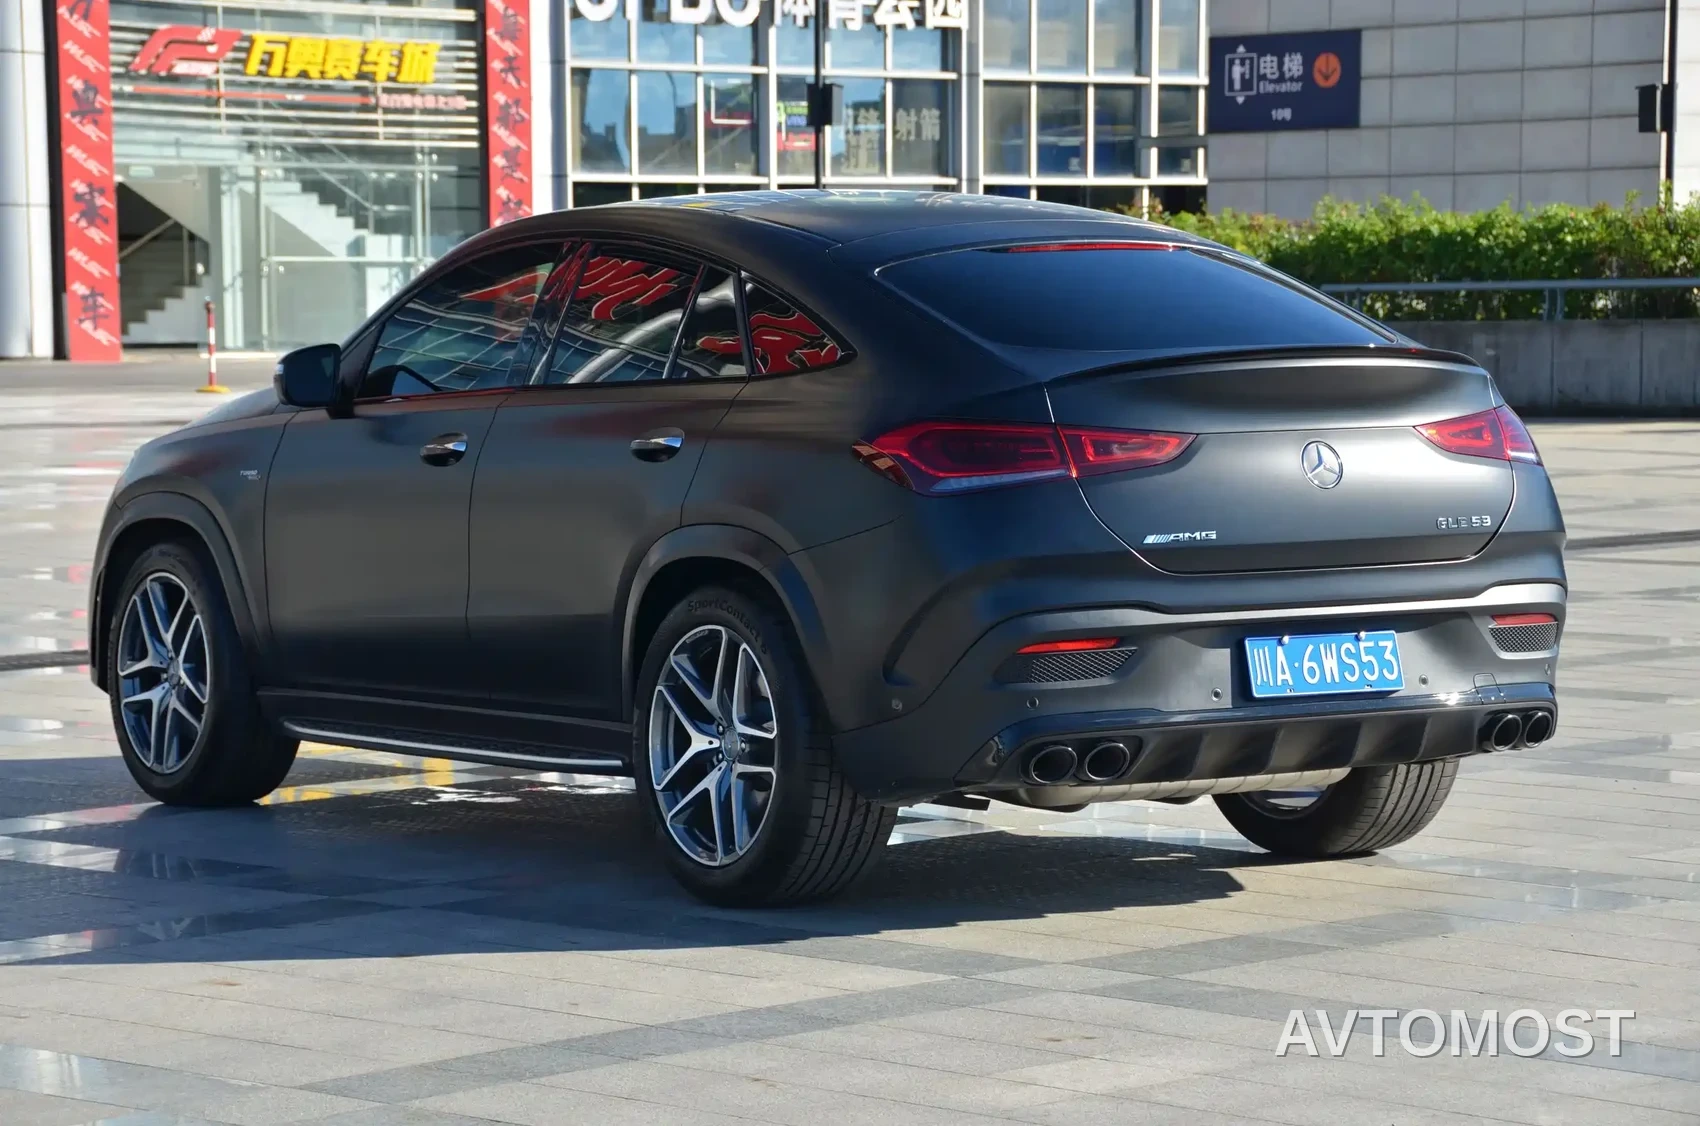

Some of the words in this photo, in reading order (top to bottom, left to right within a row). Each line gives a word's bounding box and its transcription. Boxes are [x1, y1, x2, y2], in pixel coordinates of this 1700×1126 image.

[245, 33, 441, 84] 万奥赛车城
[1259, 52, 1304, 80] 电梯
[1259, 80, 1303, 94] Elevator
[895, 107, 941, 142] 射箭
[1436, 516, 1468, 530] GLE
[1471, 515, 1491, 527] 53
[1167, 530, 1217, 542] AMG
